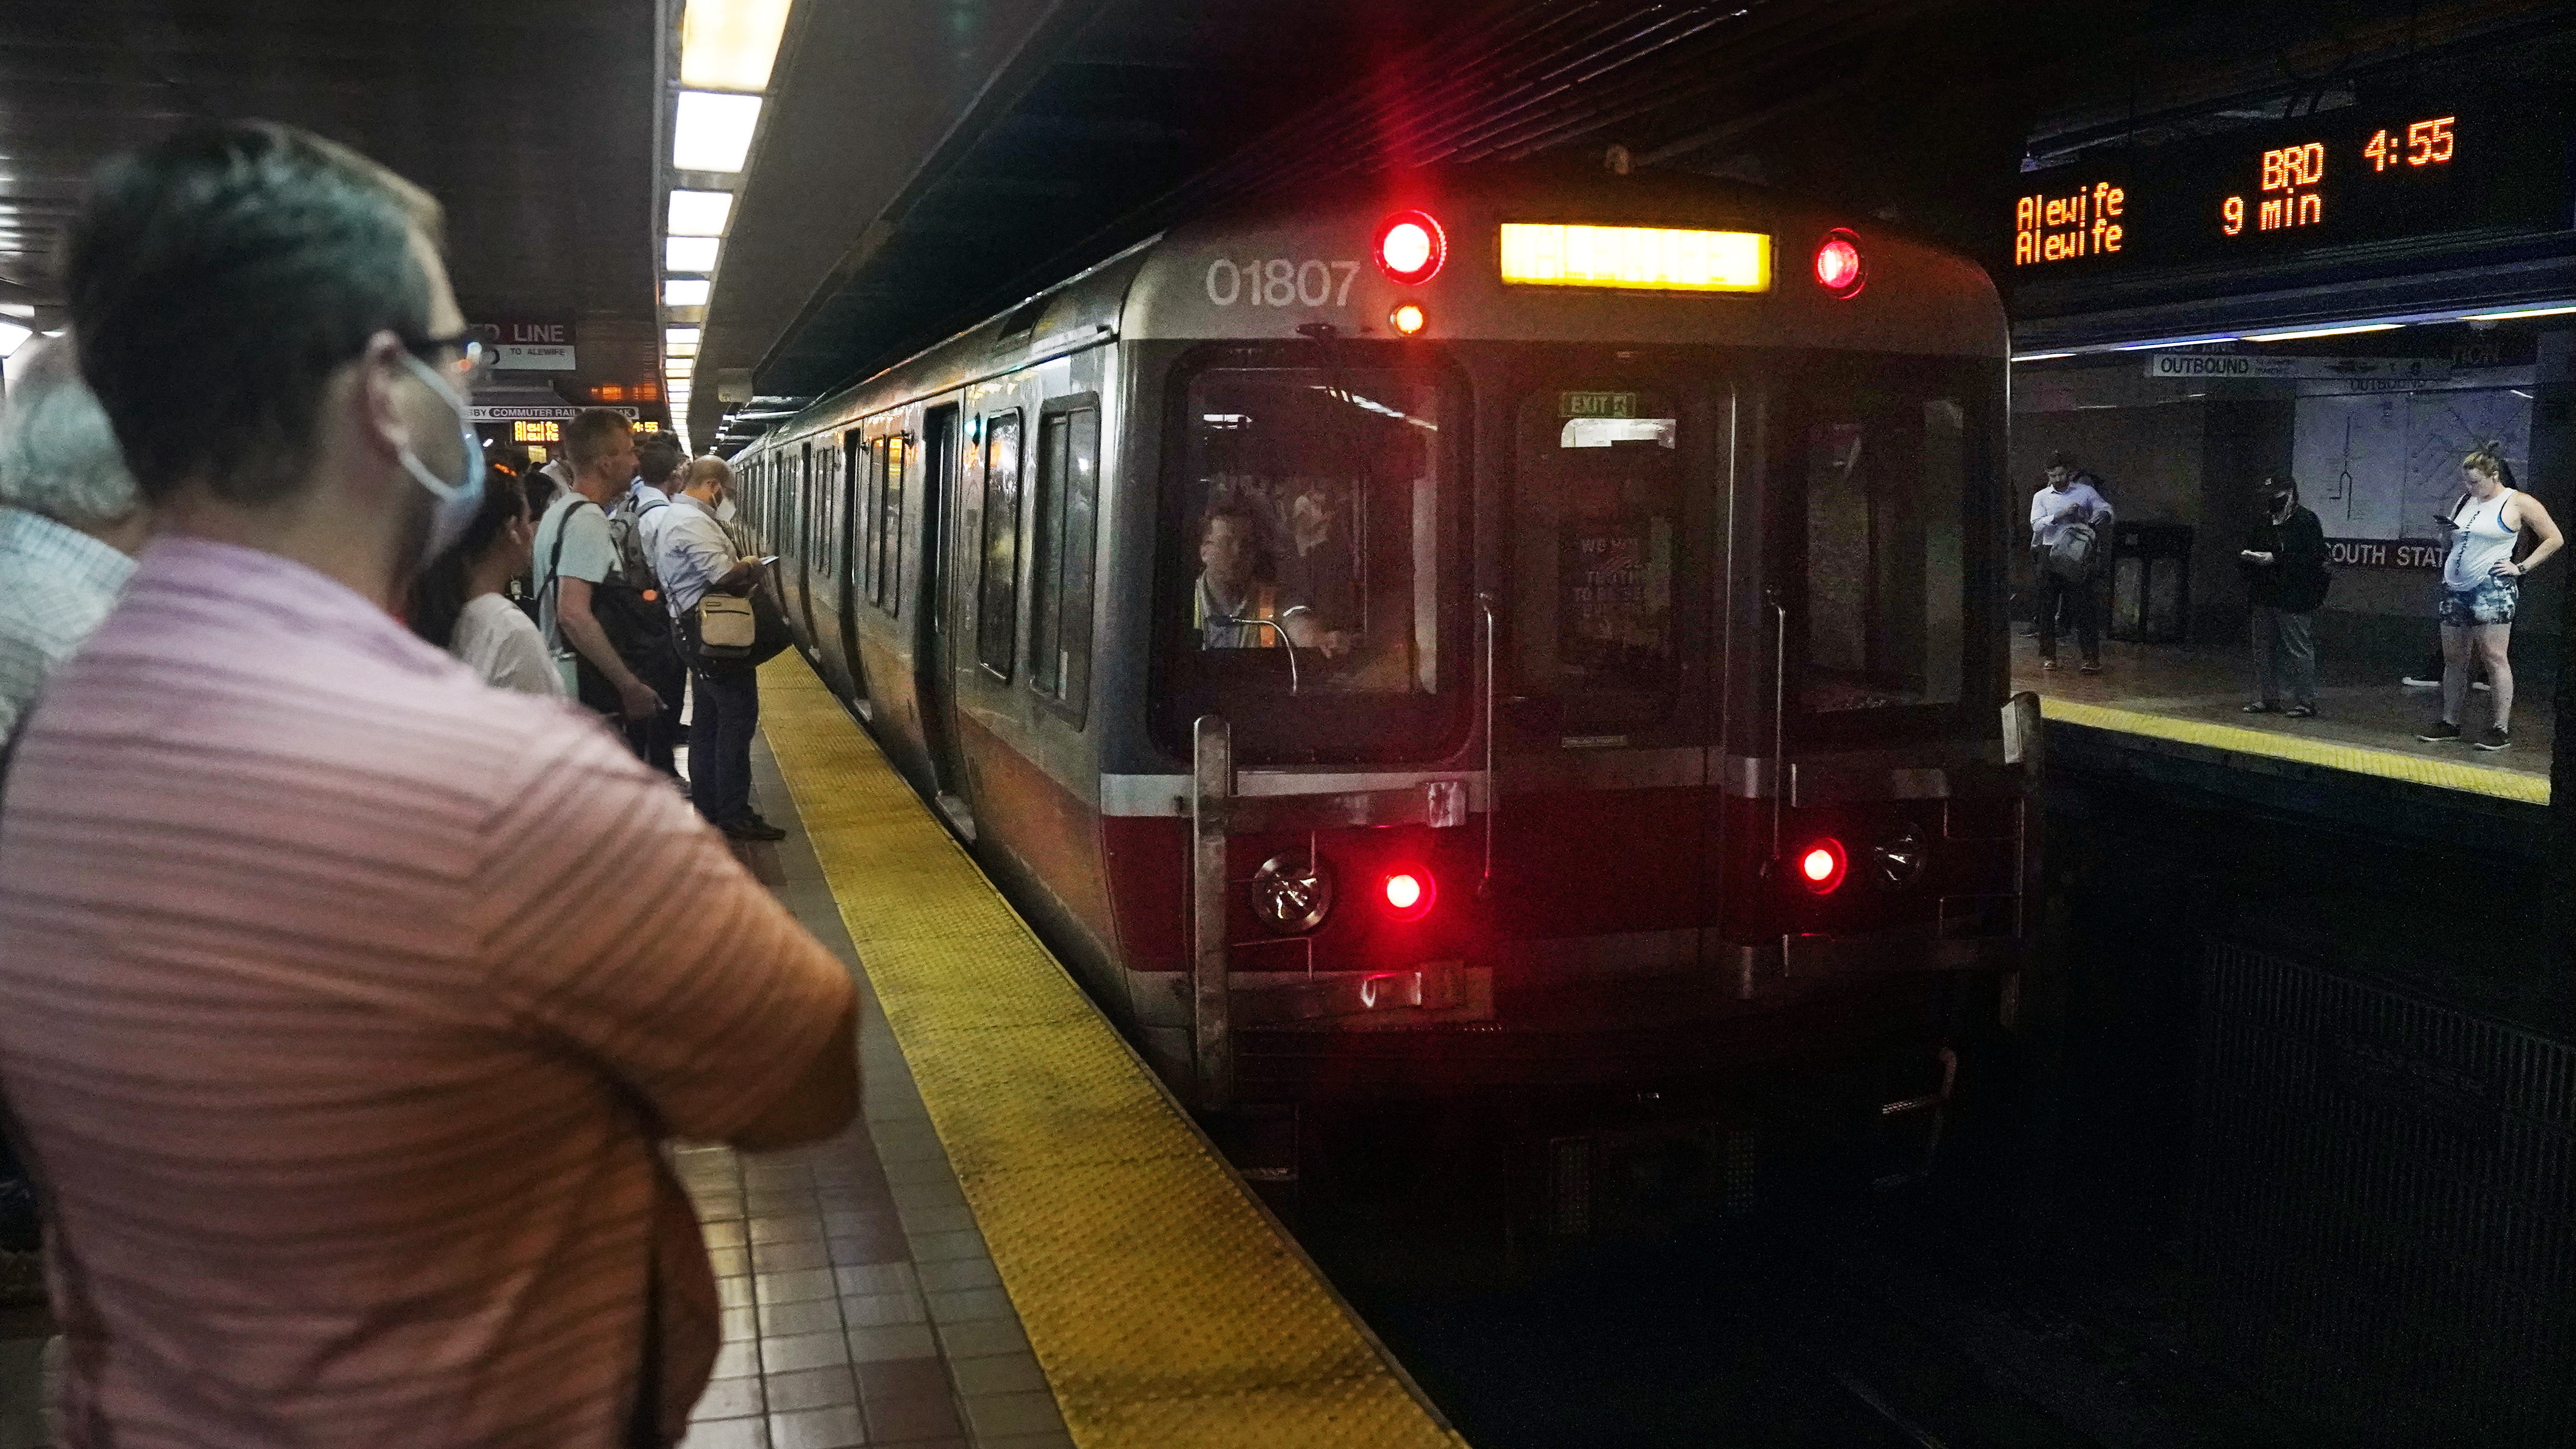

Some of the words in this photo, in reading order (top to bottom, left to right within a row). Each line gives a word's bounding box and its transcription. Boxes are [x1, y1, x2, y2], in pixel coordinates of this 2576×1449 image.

[2017, 182, 2124, 231] Alewife
[2262, 142, 2324, 191] BRD
[2363, 116, 2455, 172] 4:55
[2015, 218, 2123, 266] Alewife
[2223, 196, 2244, 236] 9
[2259, 187, 2322, 231] min
[1206, 259, 1361, 306] 01807
[514, 324, 563, 342] LINE
[2161, 357, 2248, 373] OUTBOUND
[1571, 395, 1607, 413] EXIT
[515, 421, 559, 432] Alewife
[633, 421, 658, 433] 4:55
[515, 431, 559, 441] Alewife
[2396, 545, 2444, 568] STAT
